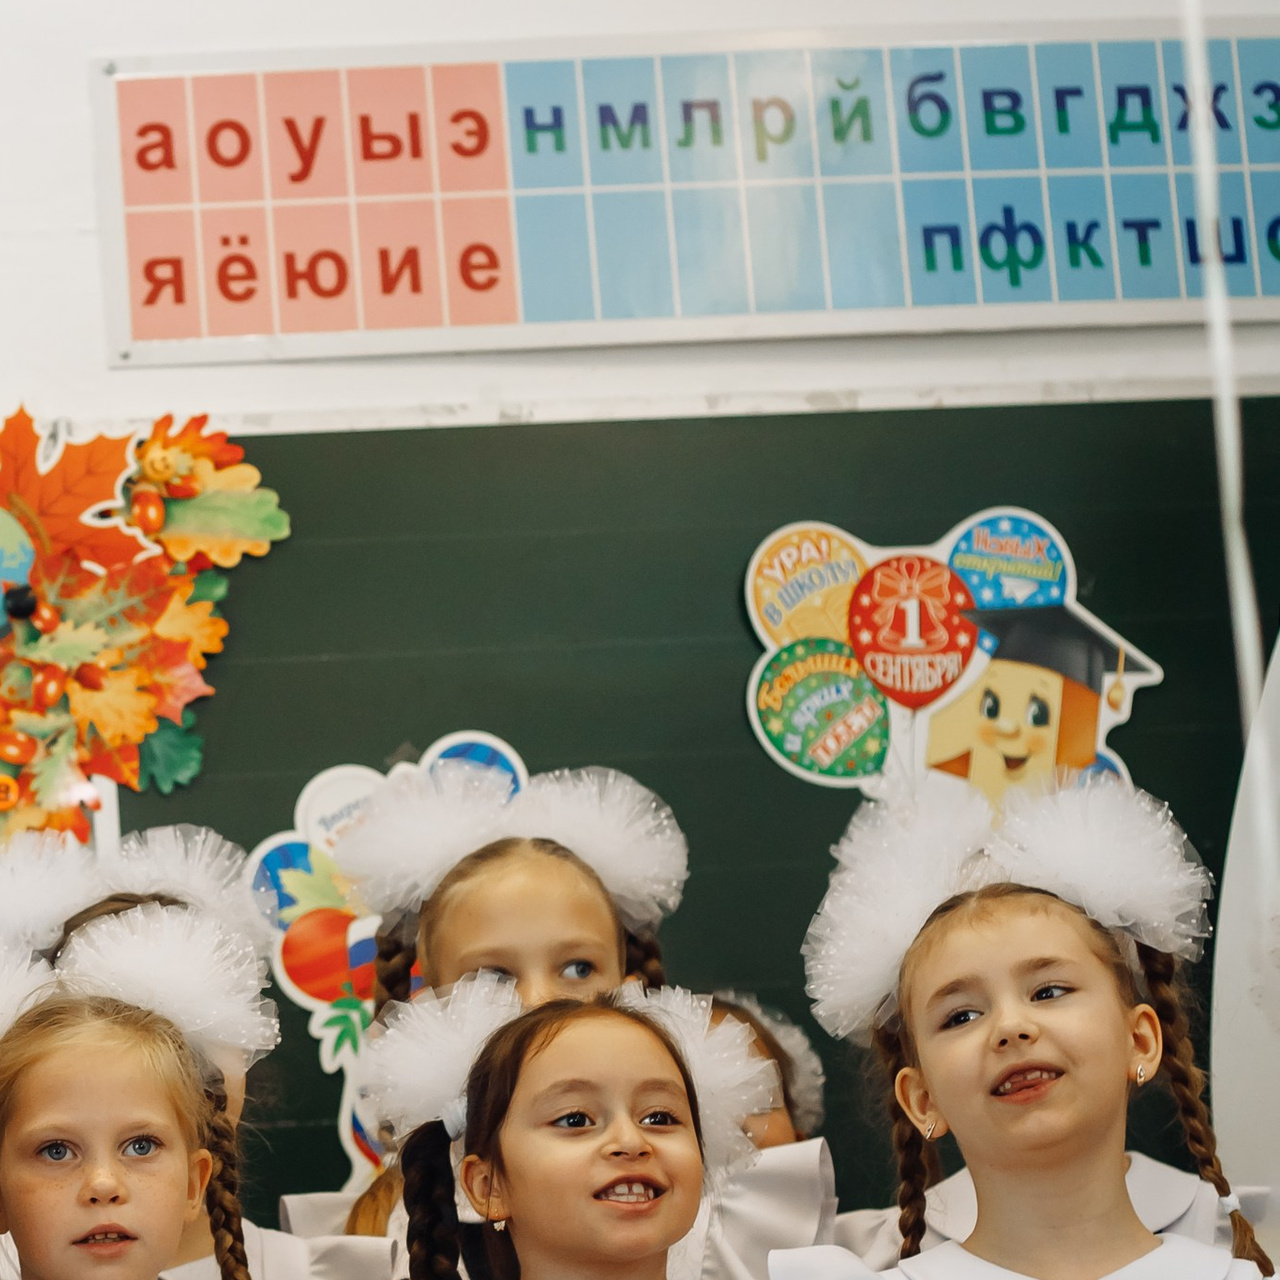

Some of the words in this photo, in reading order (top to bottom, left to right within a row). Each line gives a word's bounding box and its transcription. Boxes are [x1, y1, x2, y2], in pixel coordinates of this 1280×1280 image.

[135, 121, 177, 172] а
[206, 118, 251, 168] о
[282, 116, 326, 183] у
[358, 111, 423, 162] ы
[449, 108, 490, 158] э
[523, 105, 566, 155] н
[598, 102, 652, 152] м
[677, 98, 723, 149] л
[752, 95, 796, 163] р
[830, 77, 874, 145] й
[906, 70, 952, 138] б
[981, 88, 1026, 136] в
[1054, 85, 1084, 134] г
[1109, 83, 1161, 145] д
[143, 257, 186, 306] я
[217, 235, 258, 303] ё
[283, 249, 348, 299] ю
[379, 246, 423, 296] и
[459, 243, 501, 293] е
[922, 224, 964, 273] п
[979, 204, 1045, 288] ф
[1065, 220, 1104, 269] к
[1122, 218, 1161, 267] т
[761, 537, 830, 584] УРА!
[897, 598, 926, 648] 1
